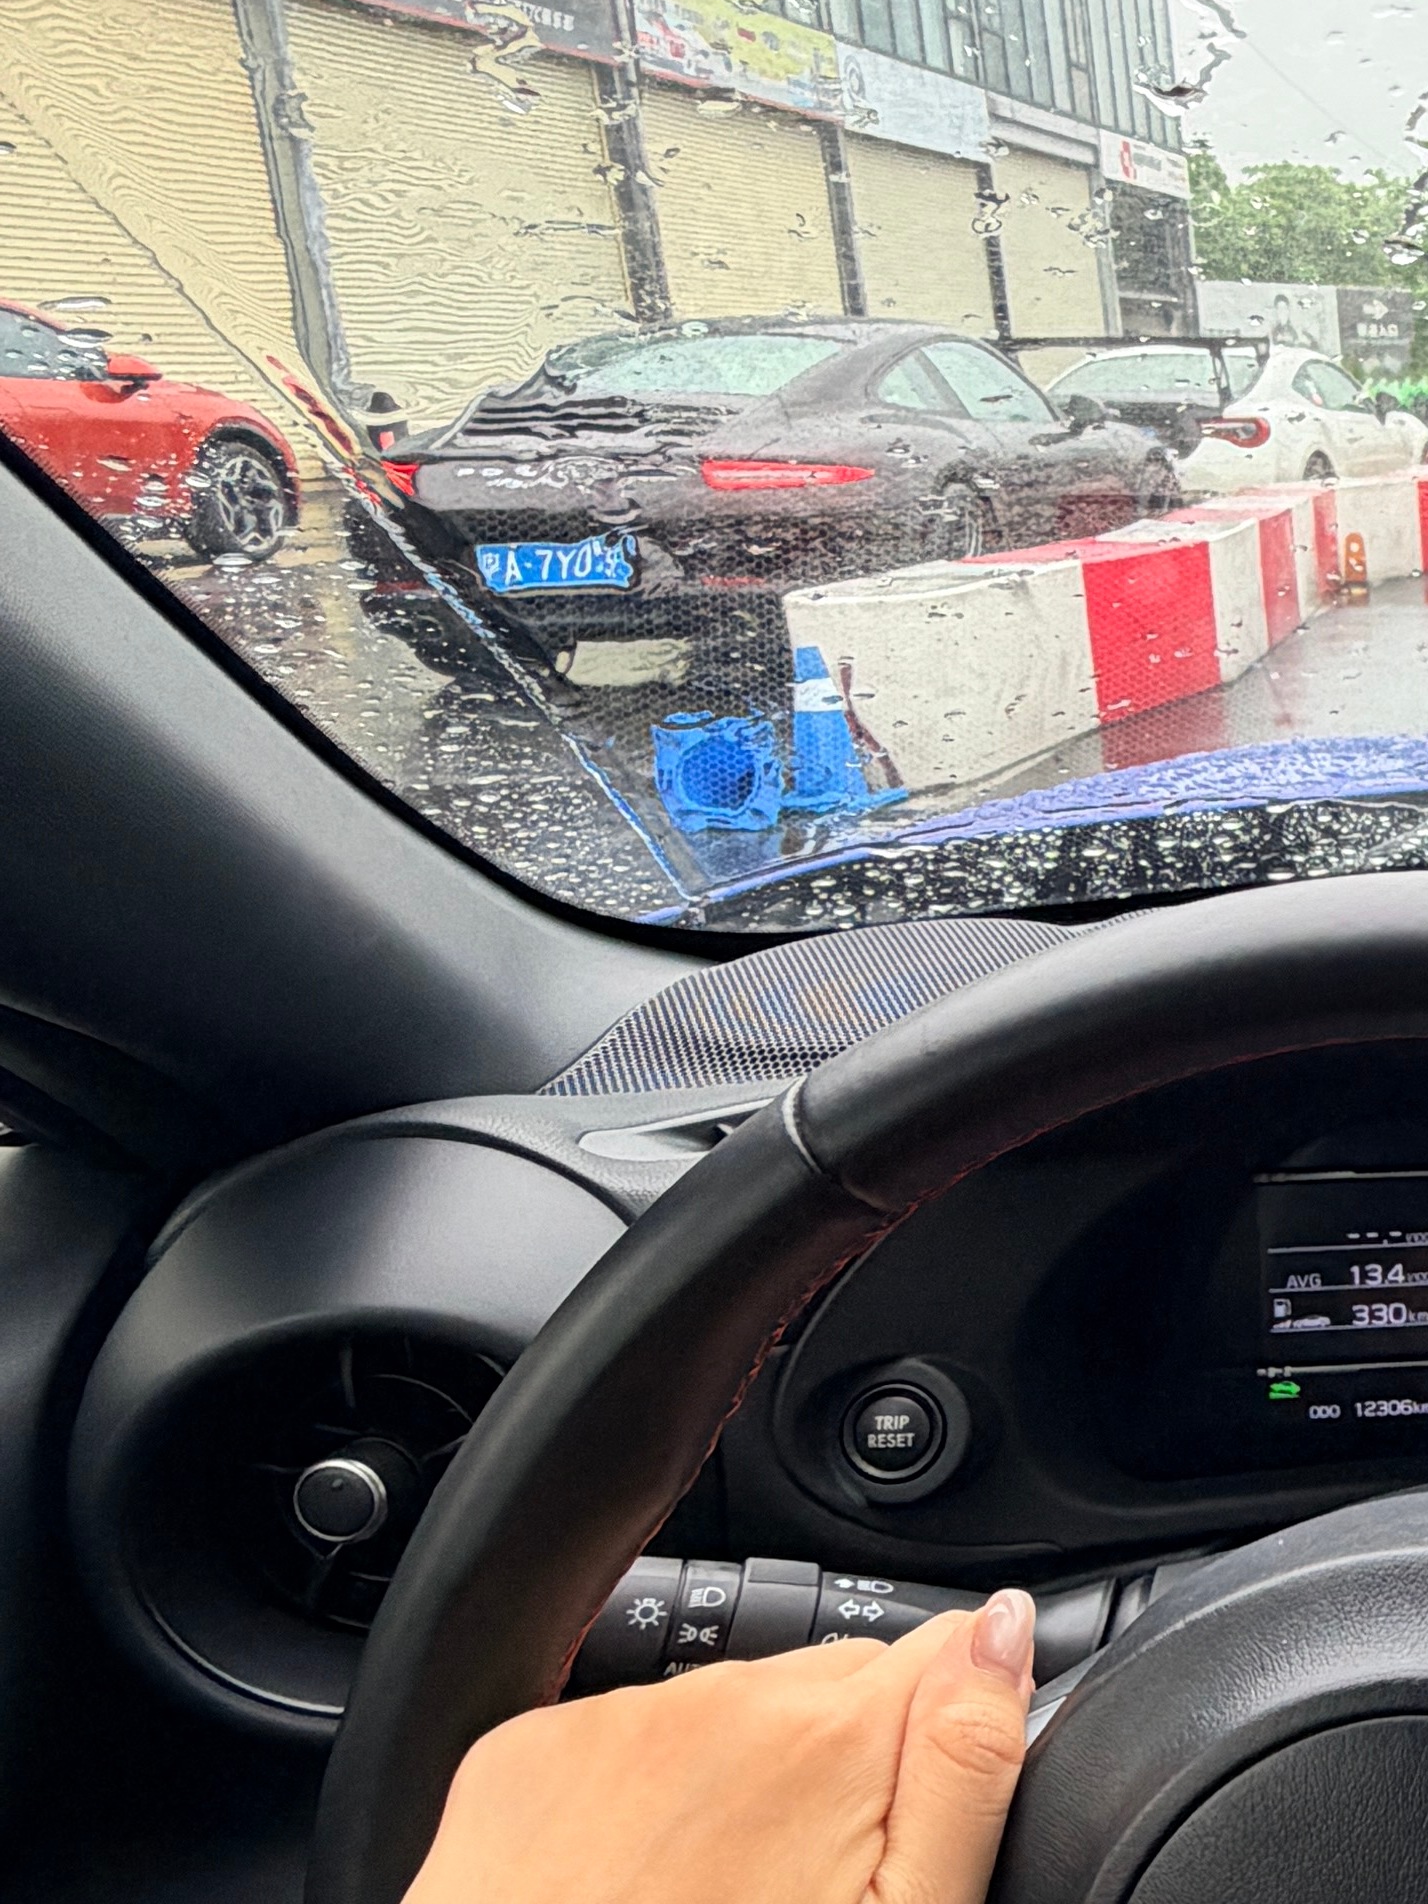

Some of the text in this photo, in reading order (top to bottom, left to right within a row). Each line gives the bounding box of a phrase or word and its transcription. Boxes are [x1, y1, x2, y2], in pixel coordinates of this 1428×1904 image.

[1287, 1273, 1322, 1289] AVG
[1350, 1263, 1405, 1286] 13.4
[875, 1415, 910, 1432] TRIP
[867, 1431, 915, 1449] RESET
